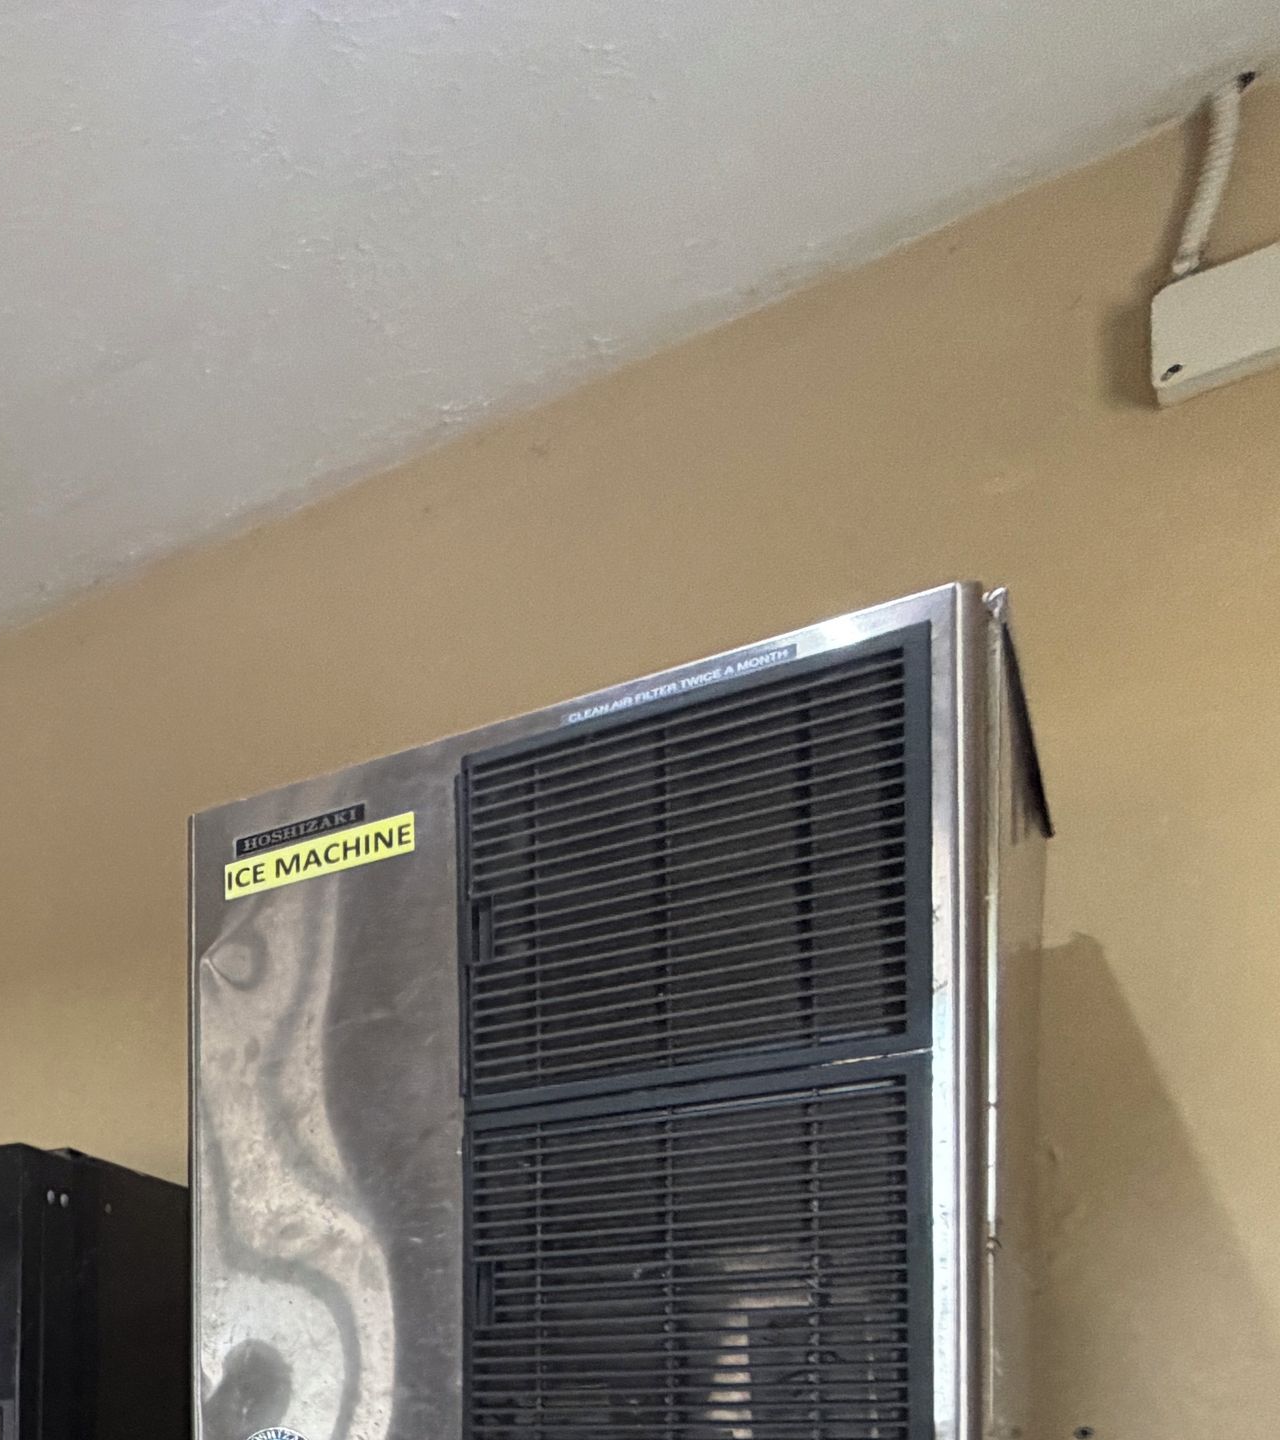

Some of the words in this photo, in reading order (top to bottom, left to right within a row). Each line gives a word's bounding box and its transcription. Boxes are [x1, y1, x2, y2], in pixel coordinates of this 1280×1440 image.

[568, 703, 612, 723] CLEAN
[611, 696, 634, 711] AIR
[634, 682, 678, 705] FILTER
[679, 668, 722, 690] TWICE
[724, 665, 735, 678] A
[736, 648, 790, 672] MONTH
[226, 862, 266, 891] ICE
[275, 822, 412, 879] MACHINE
[243, 808, 358, 852] HOSHIZAKI
